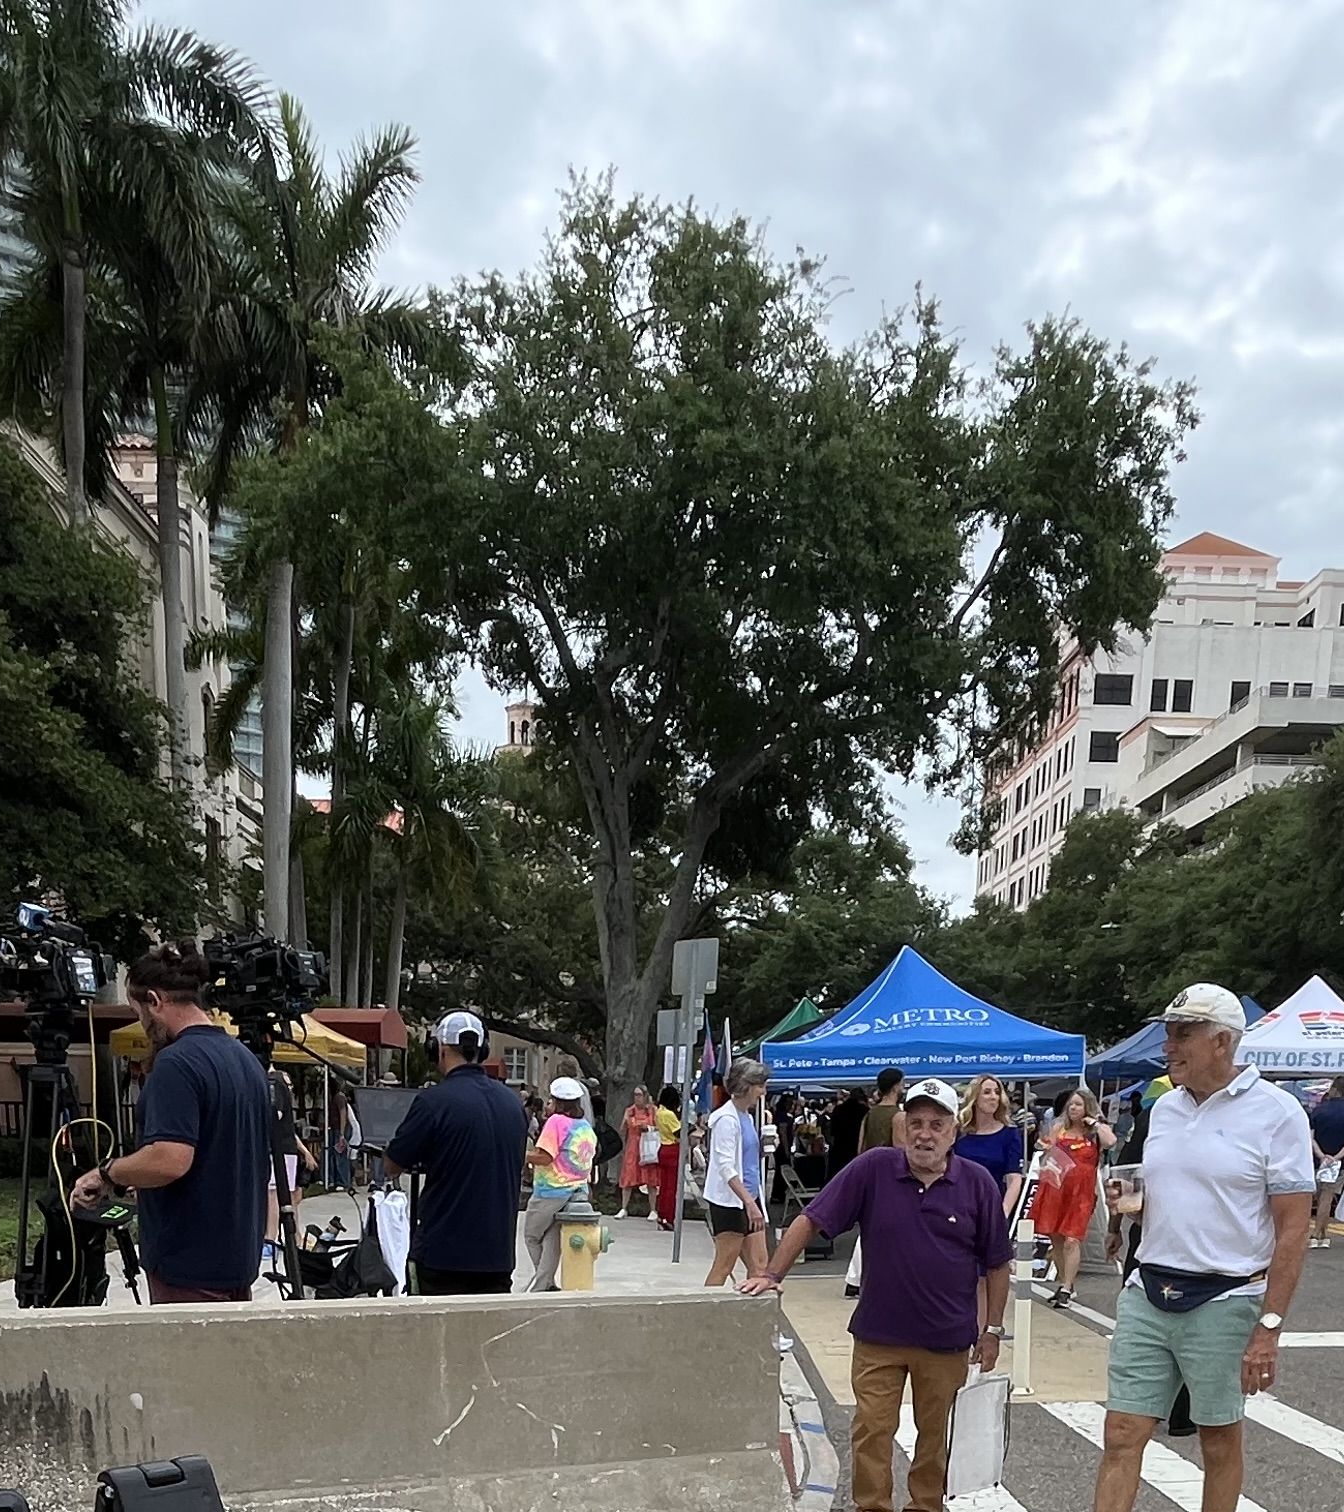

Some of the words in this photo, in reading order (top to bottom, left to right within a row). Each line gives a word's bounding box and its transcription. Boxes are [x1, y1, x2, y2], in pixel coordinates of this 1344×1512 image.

[873, 1007, 989, 1031] METRO
[788, 1058, 813, 1067] Pete
[820, 1057, 856, 1067] Tampa
[863, 1056, 920, 1065] Clearwater
[929, 1055, 953, 1063] New
[955, 1054, 977, 1063] Port
[979, 1053, 1015, 1064] Richey
[1023, 1053, 1069, 1062] Brandon
[1244, 1051, 1281, 1067] CITY
[1286, 1051, 1307, 1067] OF
